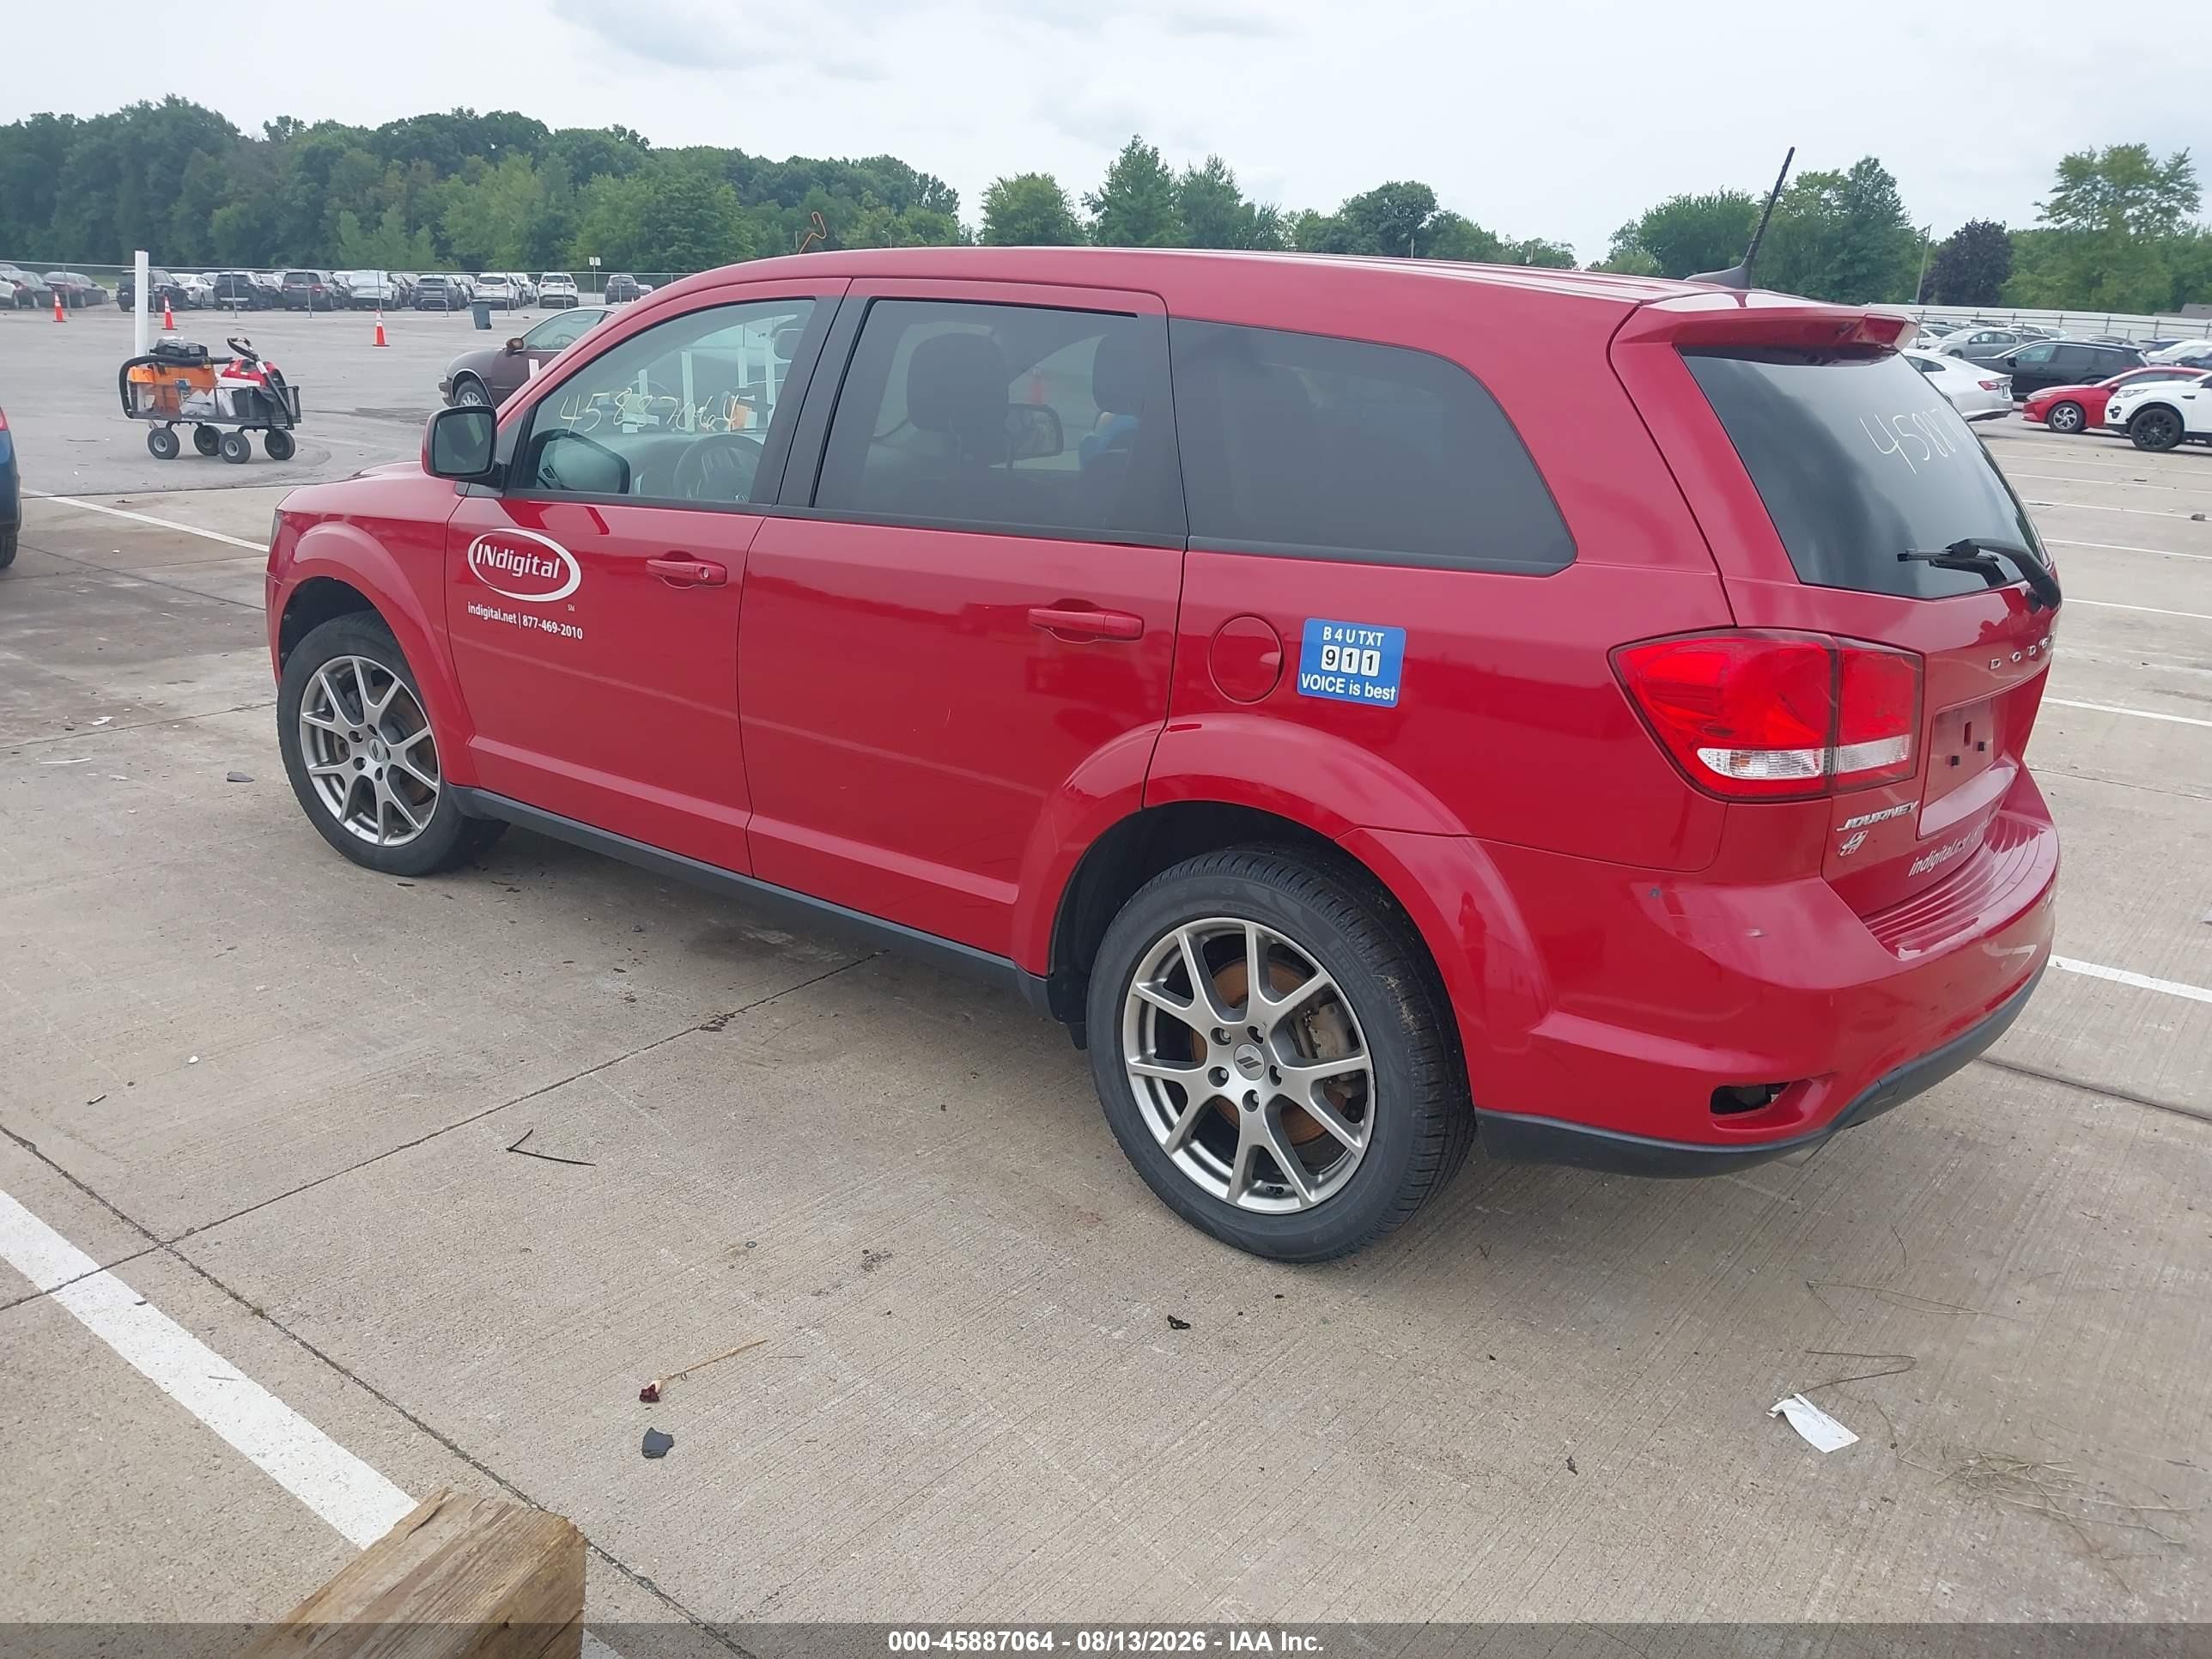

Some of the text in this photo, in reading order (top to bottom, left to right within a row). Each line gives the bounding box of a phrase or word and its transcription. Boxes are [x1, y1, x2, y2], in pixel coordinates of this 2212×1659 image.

[475, 544, 561, 579] INdigital
[467, 601, 517, 625] indigital.net
[522, 615, 584, 640] 877-469-2010
[1325, 648, 1376, 671] 911
[1301, 672, 1396, 702] VOICE is best
[1836, 800, 1920, 832] JOURNEY
